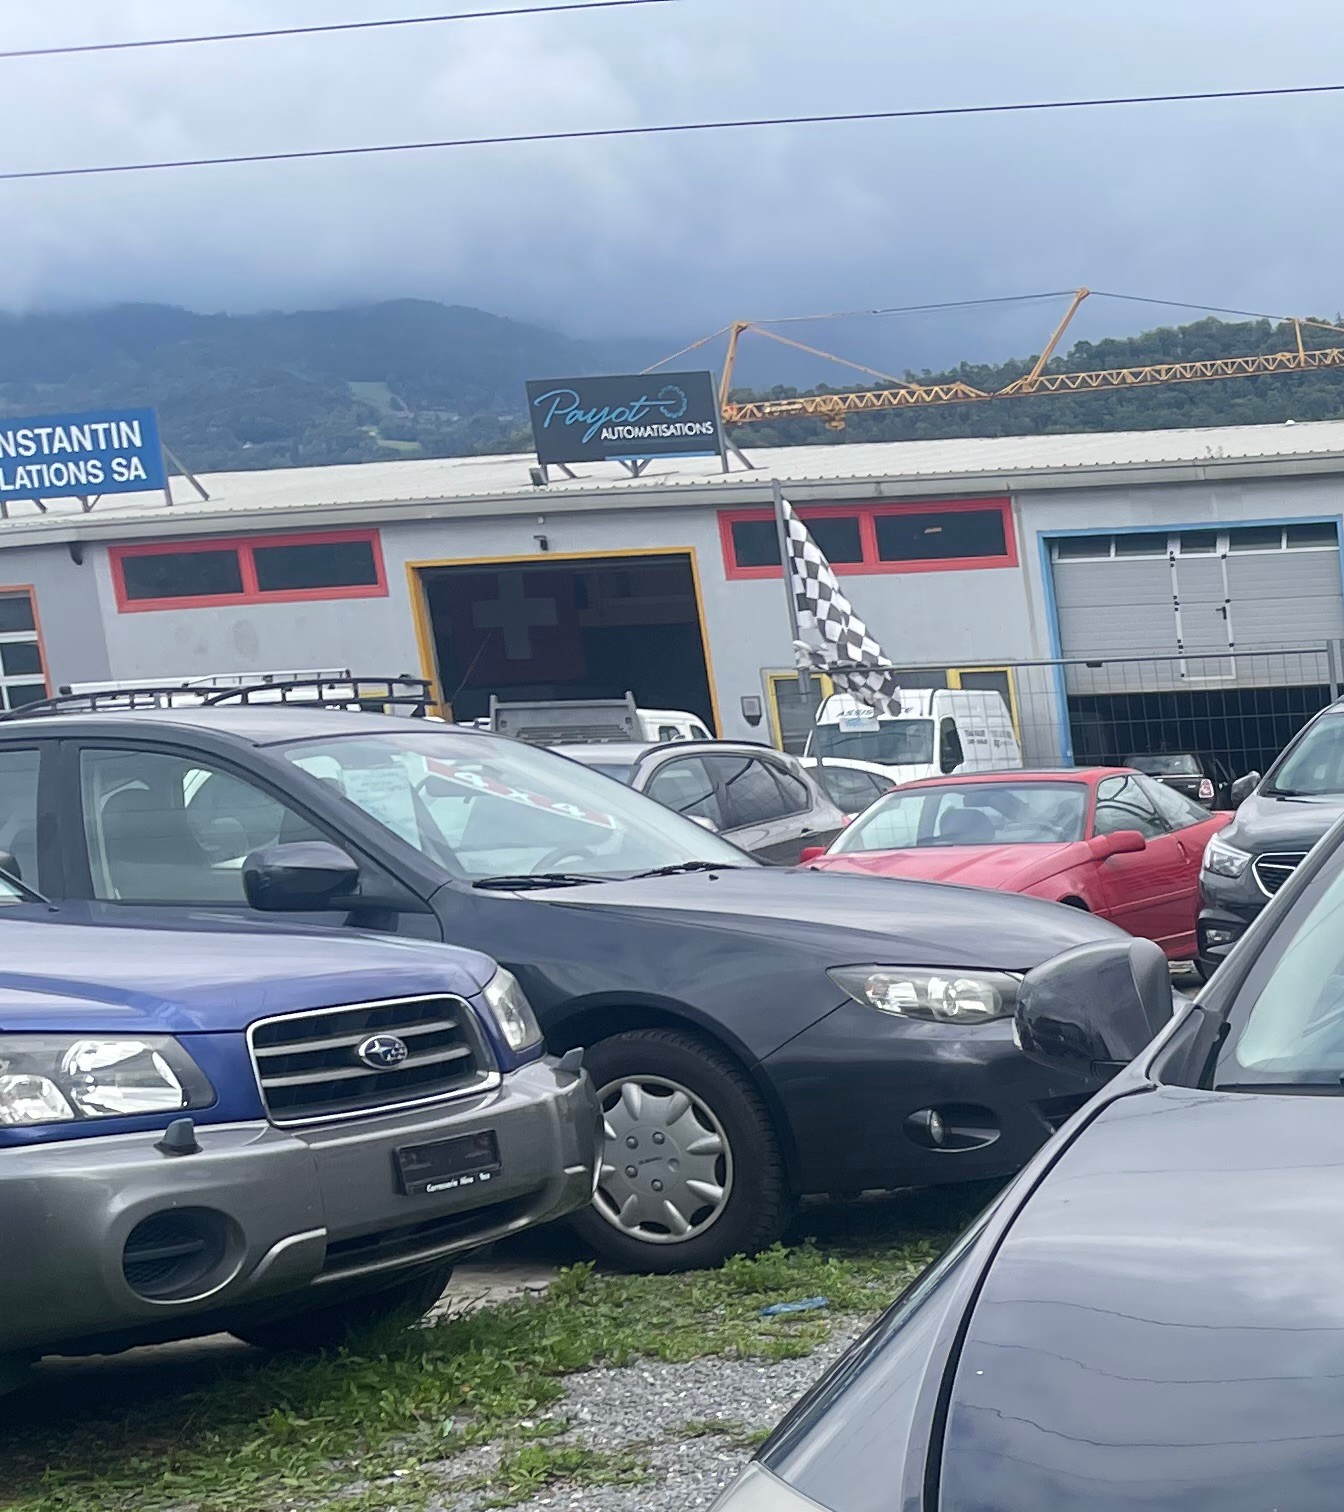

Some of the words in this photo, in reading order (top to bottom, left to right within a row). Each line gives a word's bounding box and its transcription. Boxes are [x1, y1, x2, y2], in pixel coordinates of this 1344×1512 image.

[534, 389, 660, 443] Payot
[601, 422, 714, 440] AUTOMATISATIONS
[110, 456, 147, 482] SA
